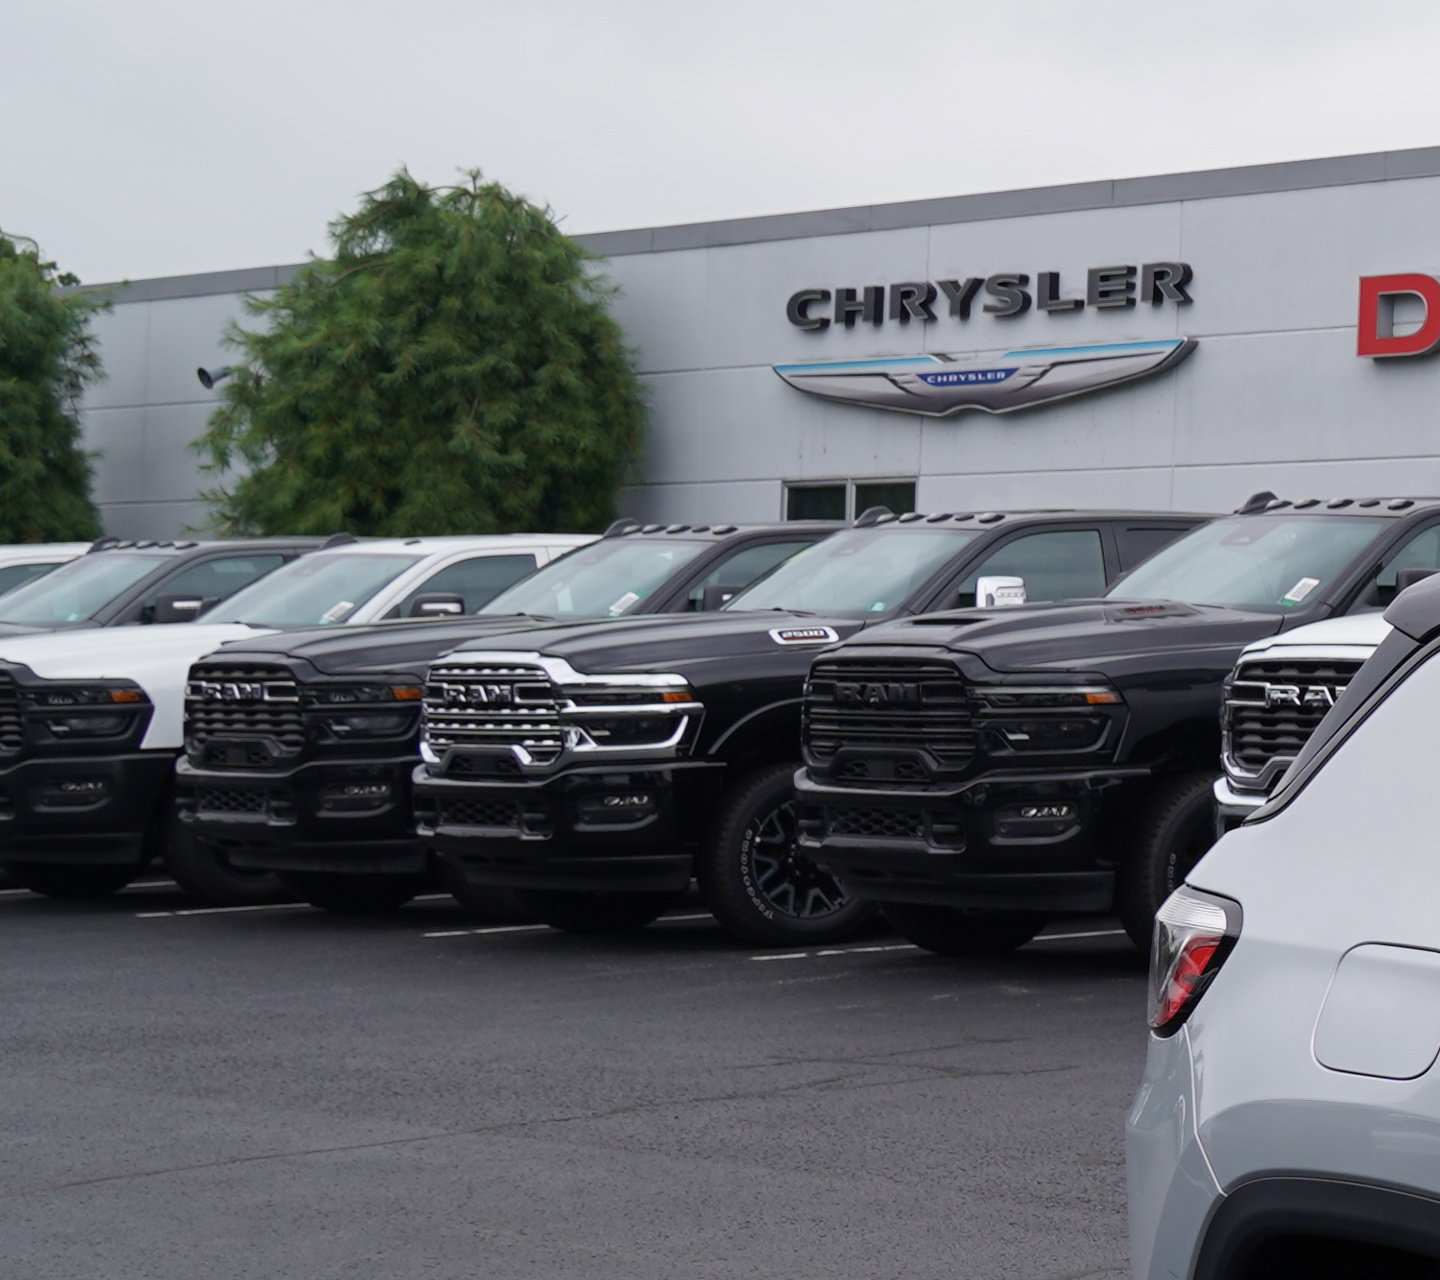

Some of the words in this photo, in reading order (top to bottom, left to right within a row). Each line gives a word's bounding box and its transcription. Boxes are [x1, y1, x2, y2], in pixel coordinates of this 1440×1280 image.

[786, 262, 1194, 331] CHRYSLER
[926, 371, 1006, 383] CHRYSLER
[782, 629, 825, 639] 2500
[203, 682, 264, 702] RAM
[444, 683, 513, 703] RAM
[836, 682, 921, 703] RAM
[1268, 685, 1347, 706] RA
